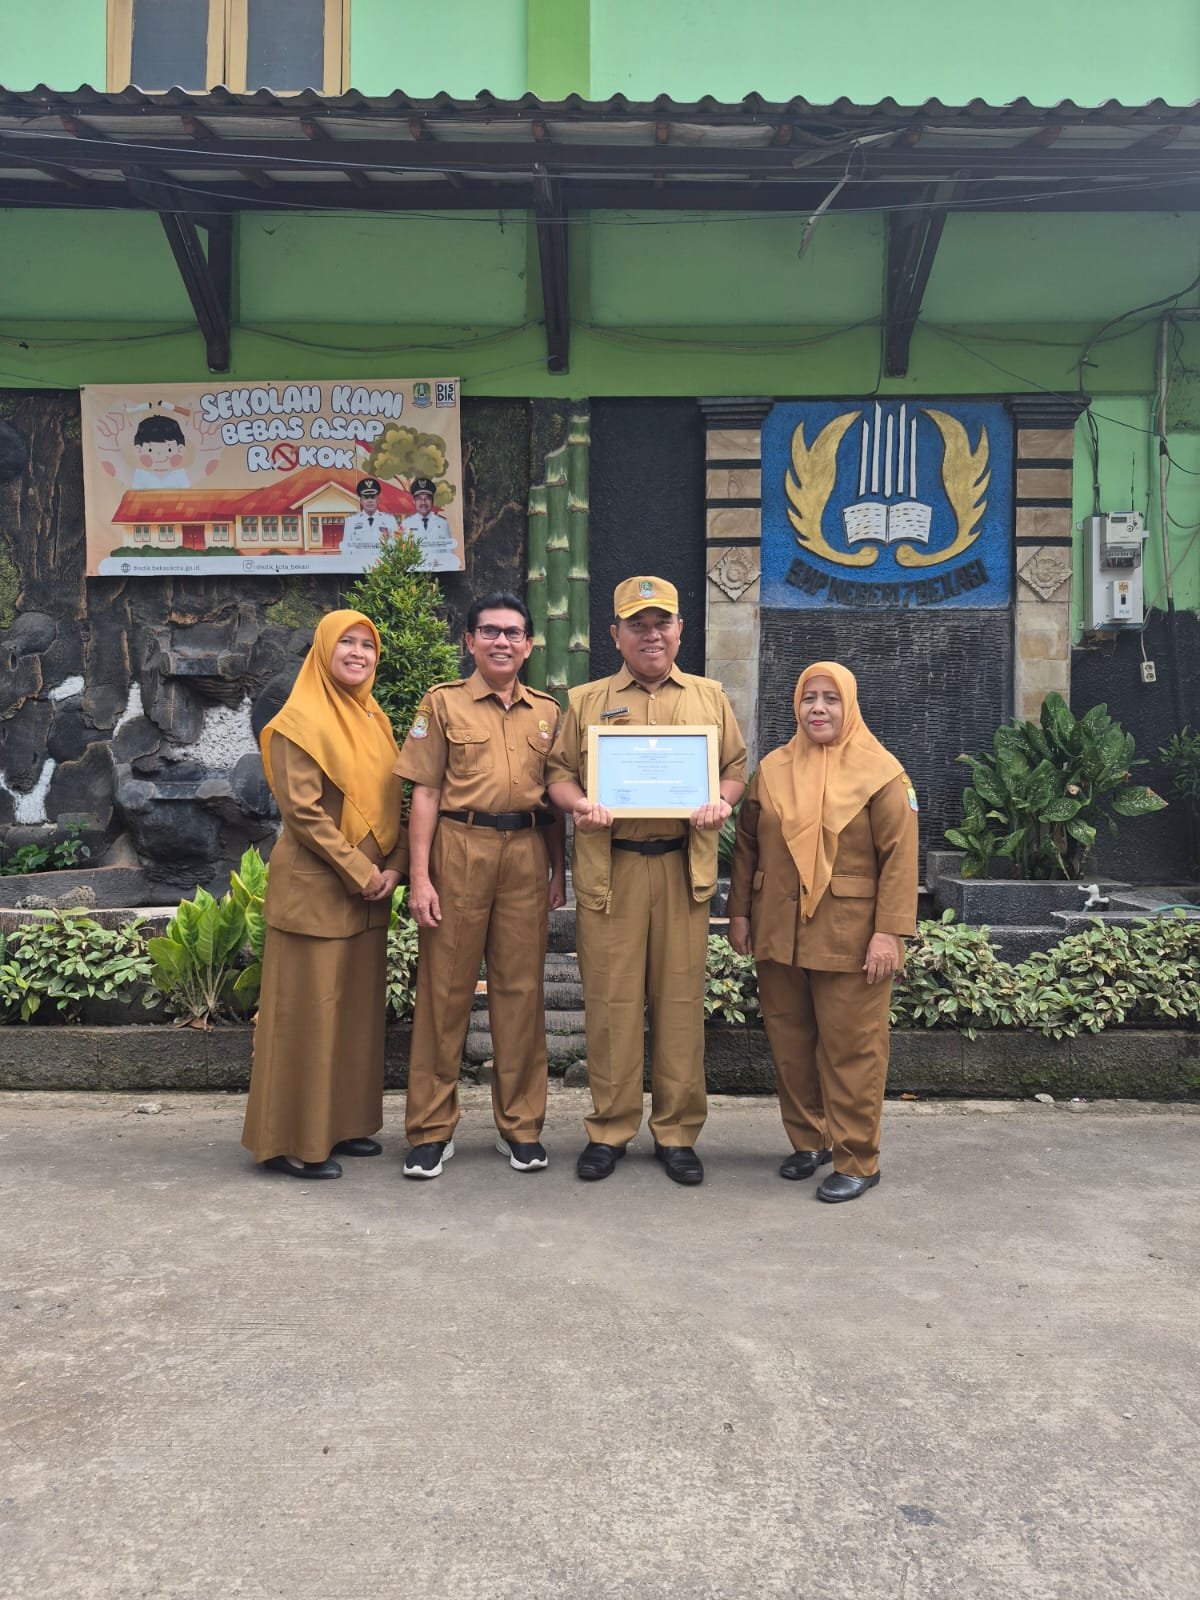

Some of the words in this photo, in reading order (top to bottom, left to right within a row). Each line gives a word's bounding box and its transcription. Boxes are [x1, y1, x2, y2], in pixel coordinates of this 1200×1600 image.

[200, 386, 321, 422] SEKOLAH
[331, 385, 403, 419] KAMI
[221, 416, 304, 445] BEBAS
[310, 416, 385, 442] ASAP
